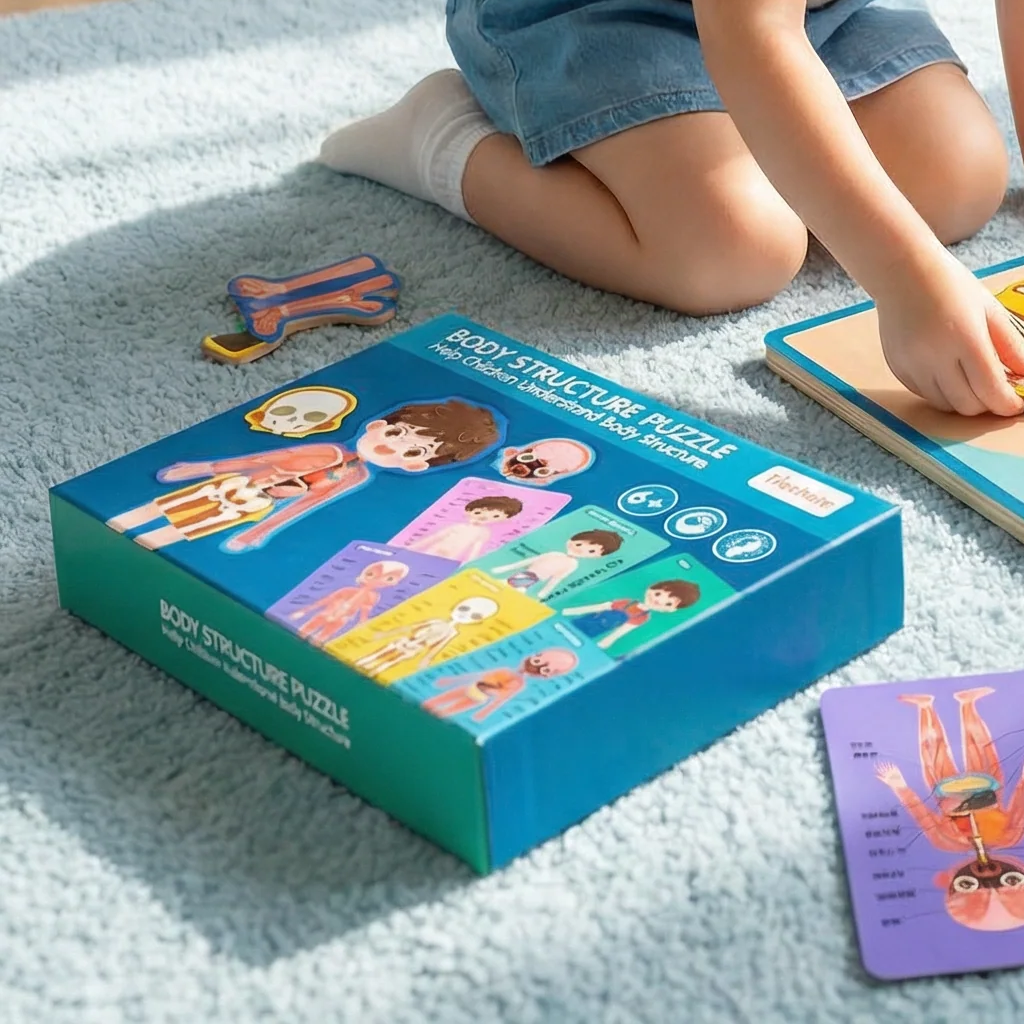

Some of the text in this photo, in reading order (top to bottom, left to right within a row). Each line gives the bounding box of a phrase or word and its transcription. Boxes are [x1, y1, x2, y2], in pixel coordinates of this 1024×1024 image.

[446, 329, 738, 460] BODY STRUCTURE PUZZLE
[160, 599, 200, 638] BODY
[202, 625, 288, 694] STRUCTURE
[290, 677, 349, 730] PUZZLE
